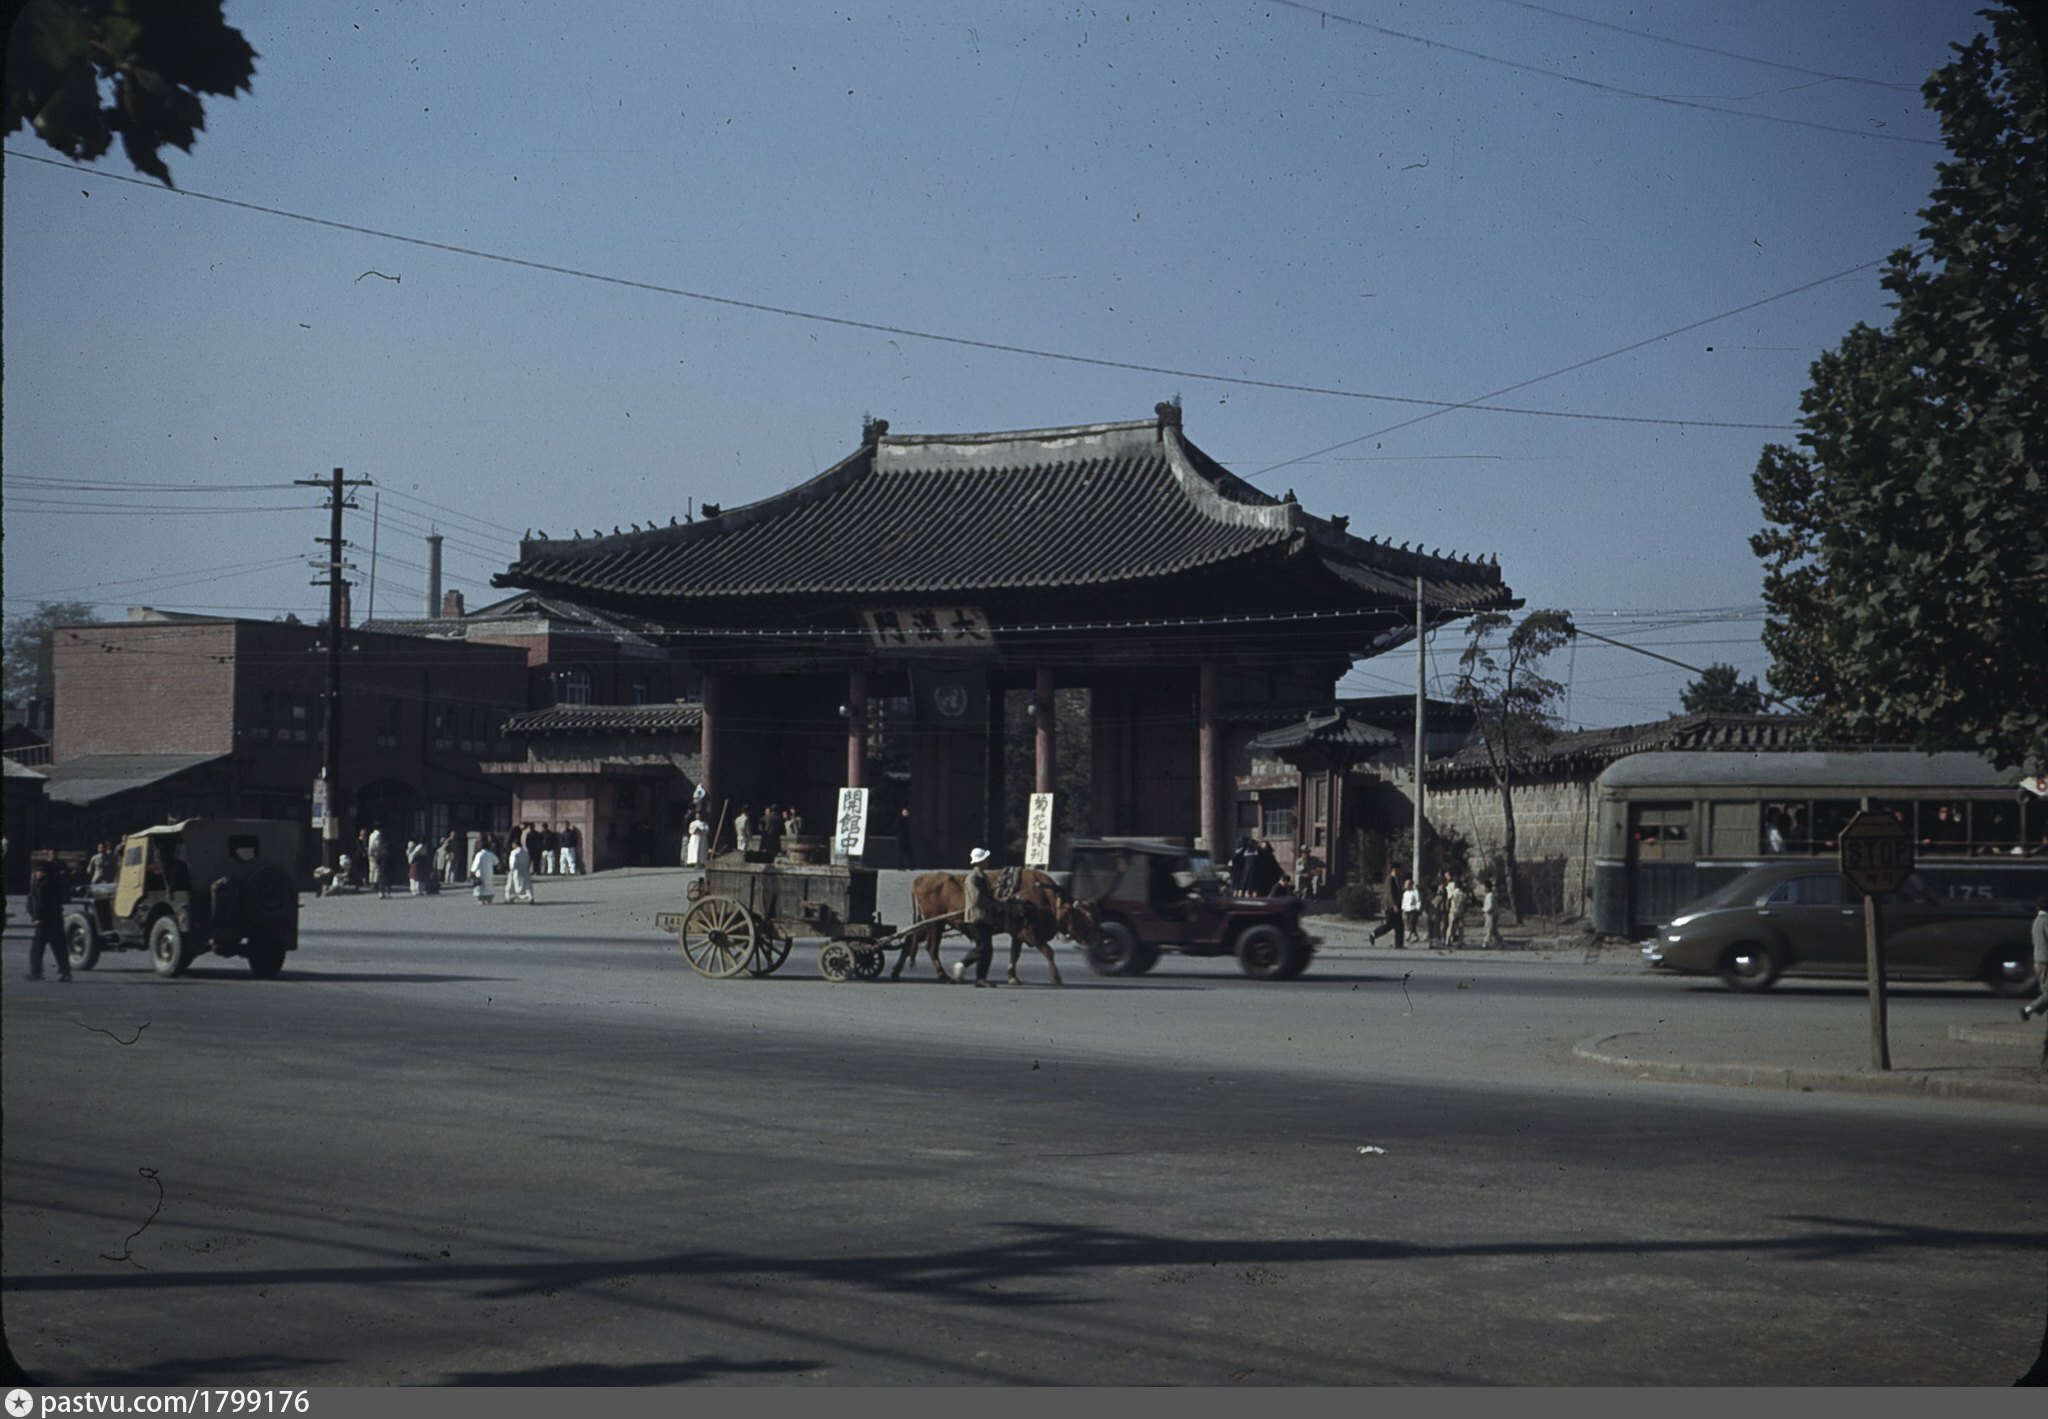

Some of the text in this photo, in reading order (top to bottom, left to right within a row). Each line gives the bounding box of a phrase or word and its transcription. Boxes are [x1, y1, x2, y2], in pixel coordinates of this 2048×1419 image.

[840, 789, 862, 853] 開館中
[1848, 840, 1909, 865] STOP
[1949, 885, 1993, 900] 175
